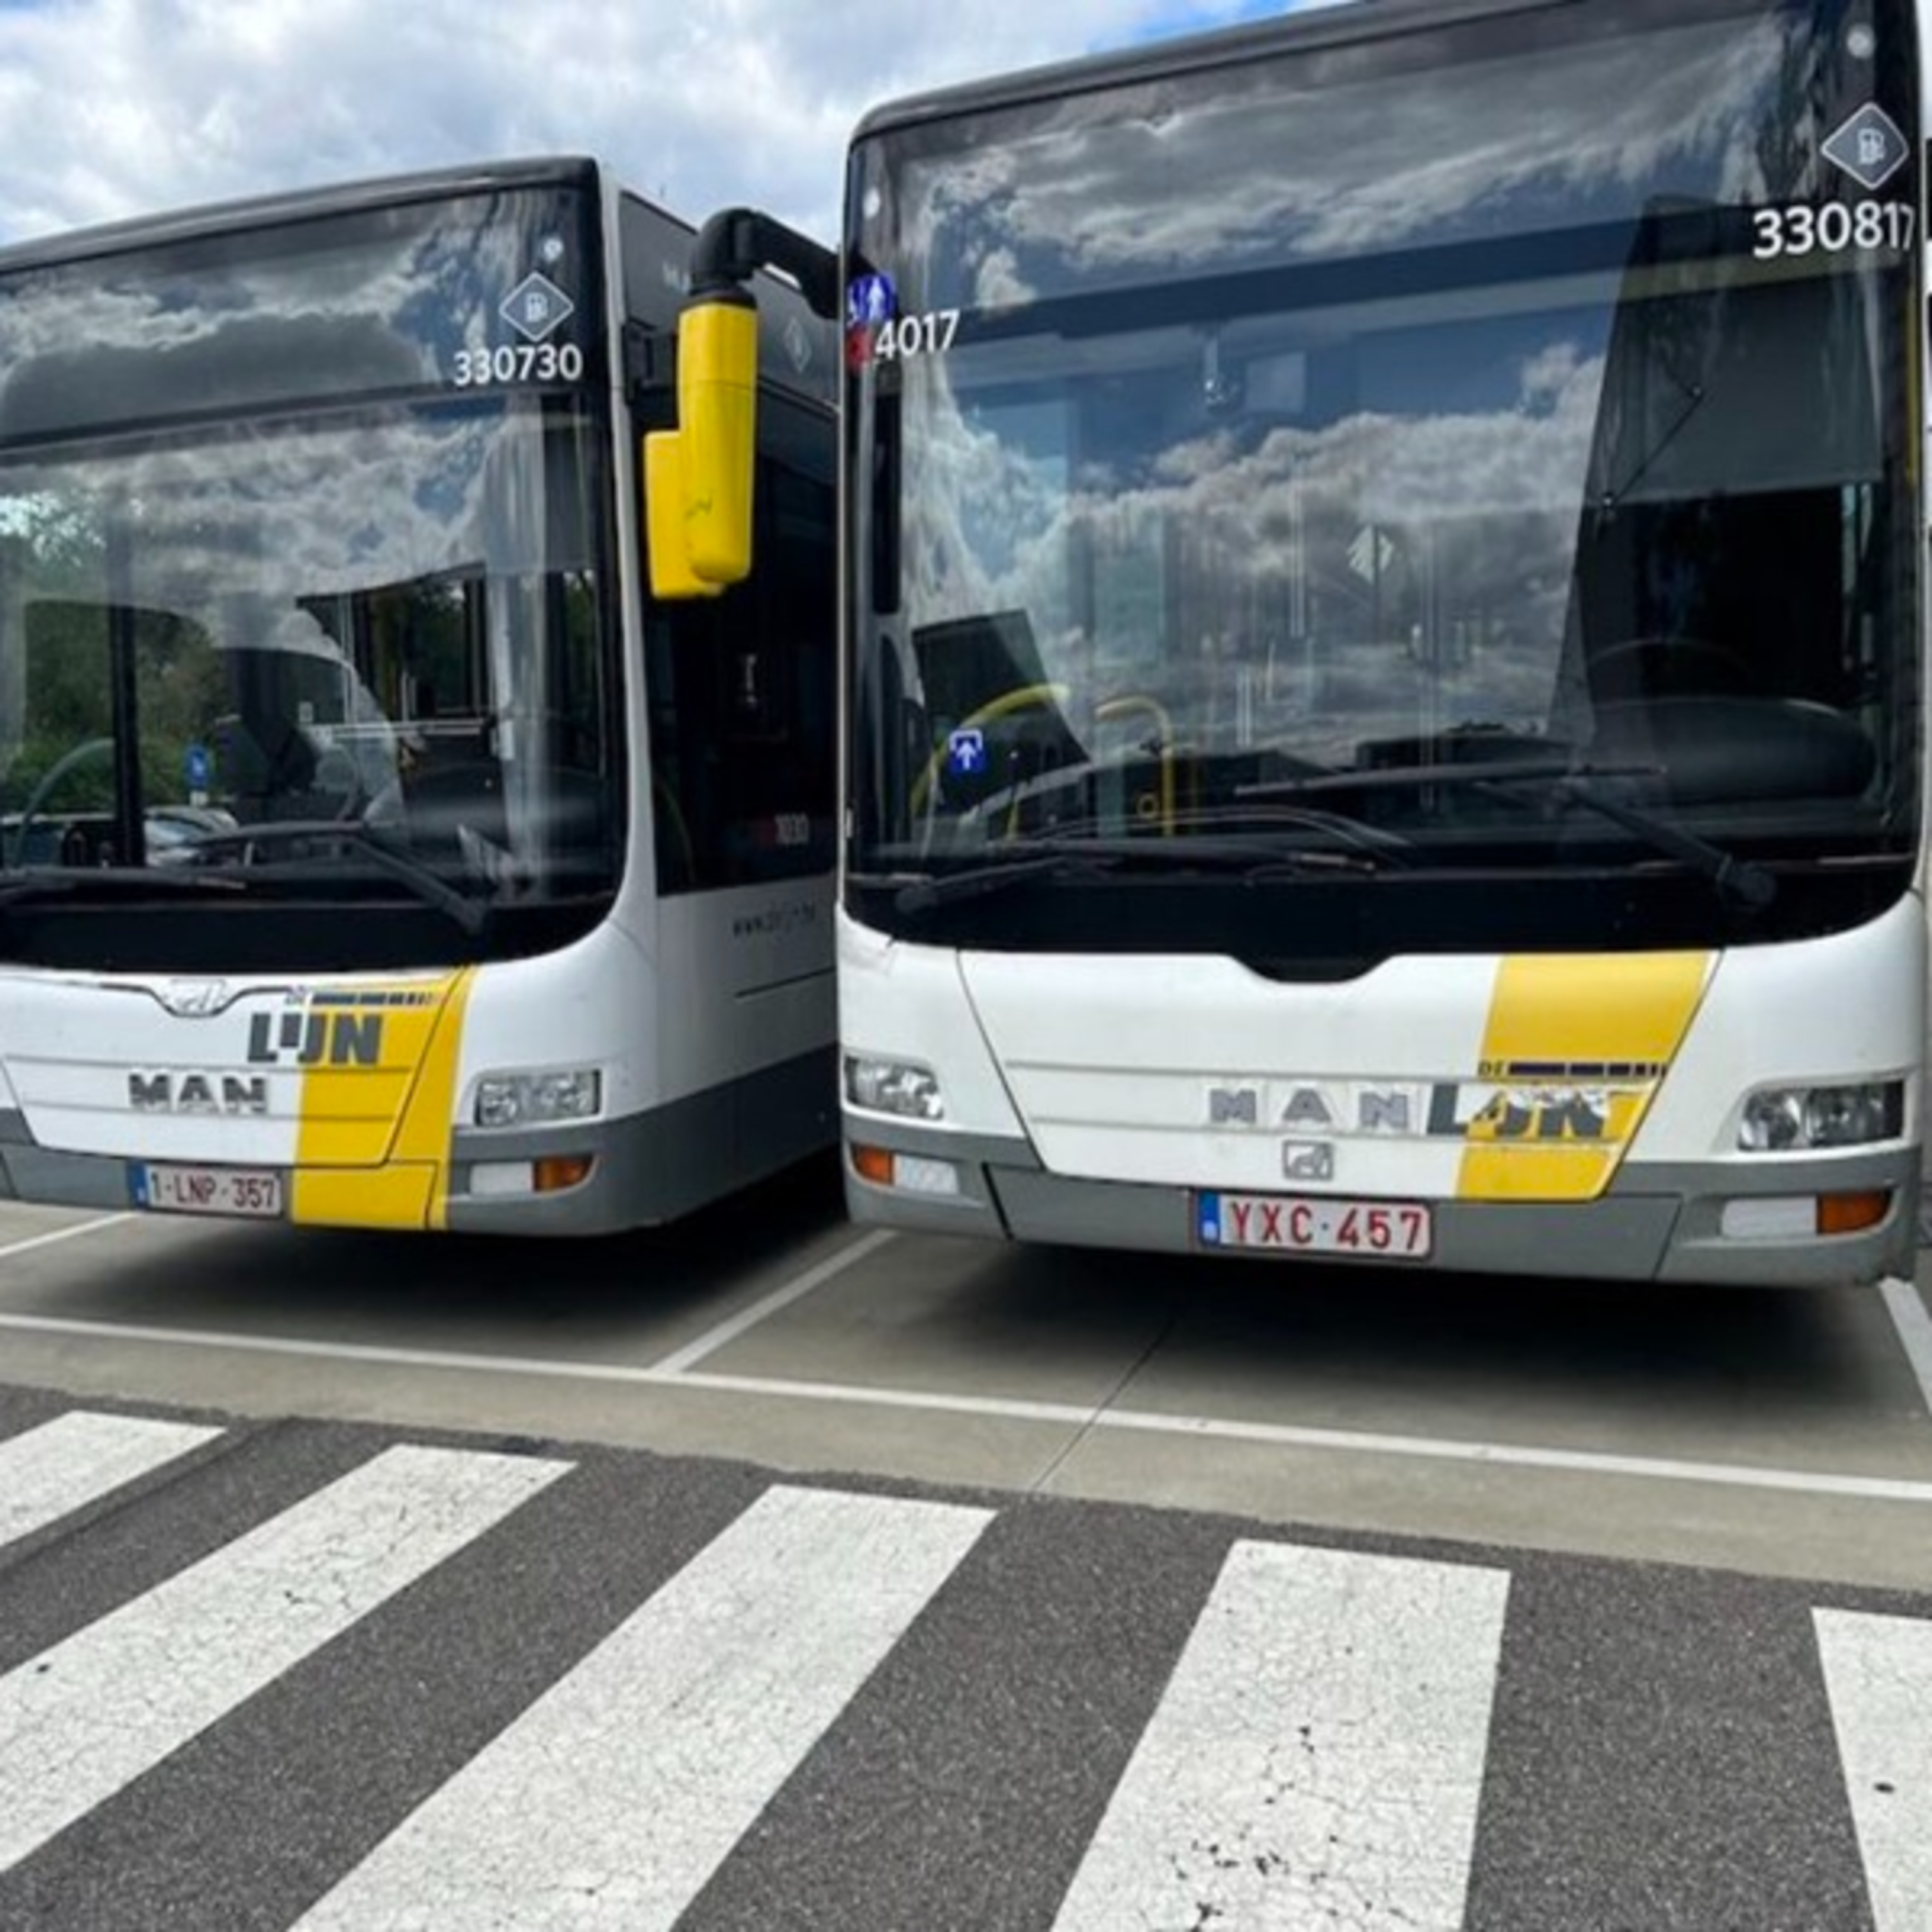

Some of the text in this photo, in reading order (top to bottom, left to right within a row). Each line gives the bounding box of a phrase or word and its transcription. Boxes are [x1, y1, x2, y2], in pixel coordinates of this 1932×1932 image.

[875, 308, 959, 359] 4017
[452, 343, 582, 385] 330730
[247, 1012, 384, 1065] LIJN
[129, 1072, 267, 1112] MAN
[1208, 1088, 1409, 1128] MAN
